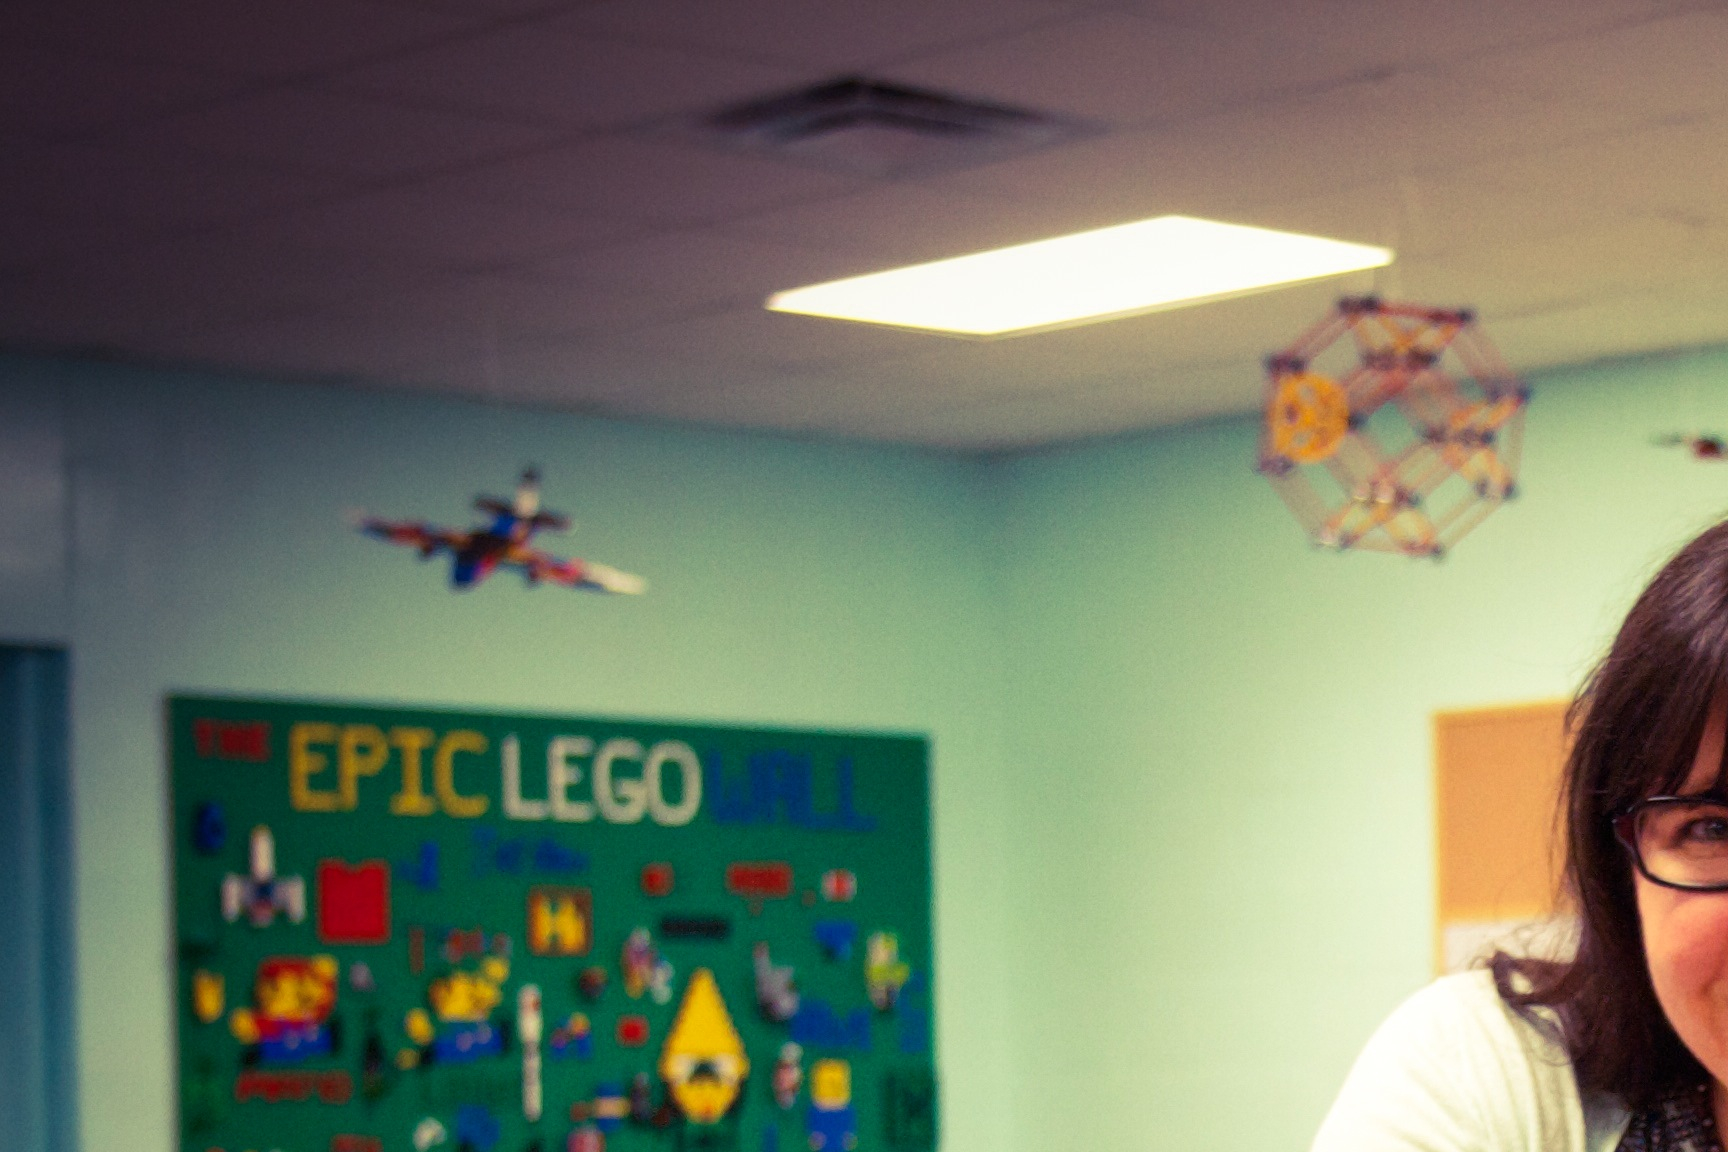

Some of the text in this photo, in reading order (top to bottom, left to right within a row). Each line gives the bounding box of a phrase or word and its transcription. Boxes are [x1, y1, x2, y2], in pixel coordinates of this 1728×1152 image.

[289, 722, 489, 818] EPIC
[502, 732, 703, 826] LEGO
[706, 747, 877, 832] WALL
